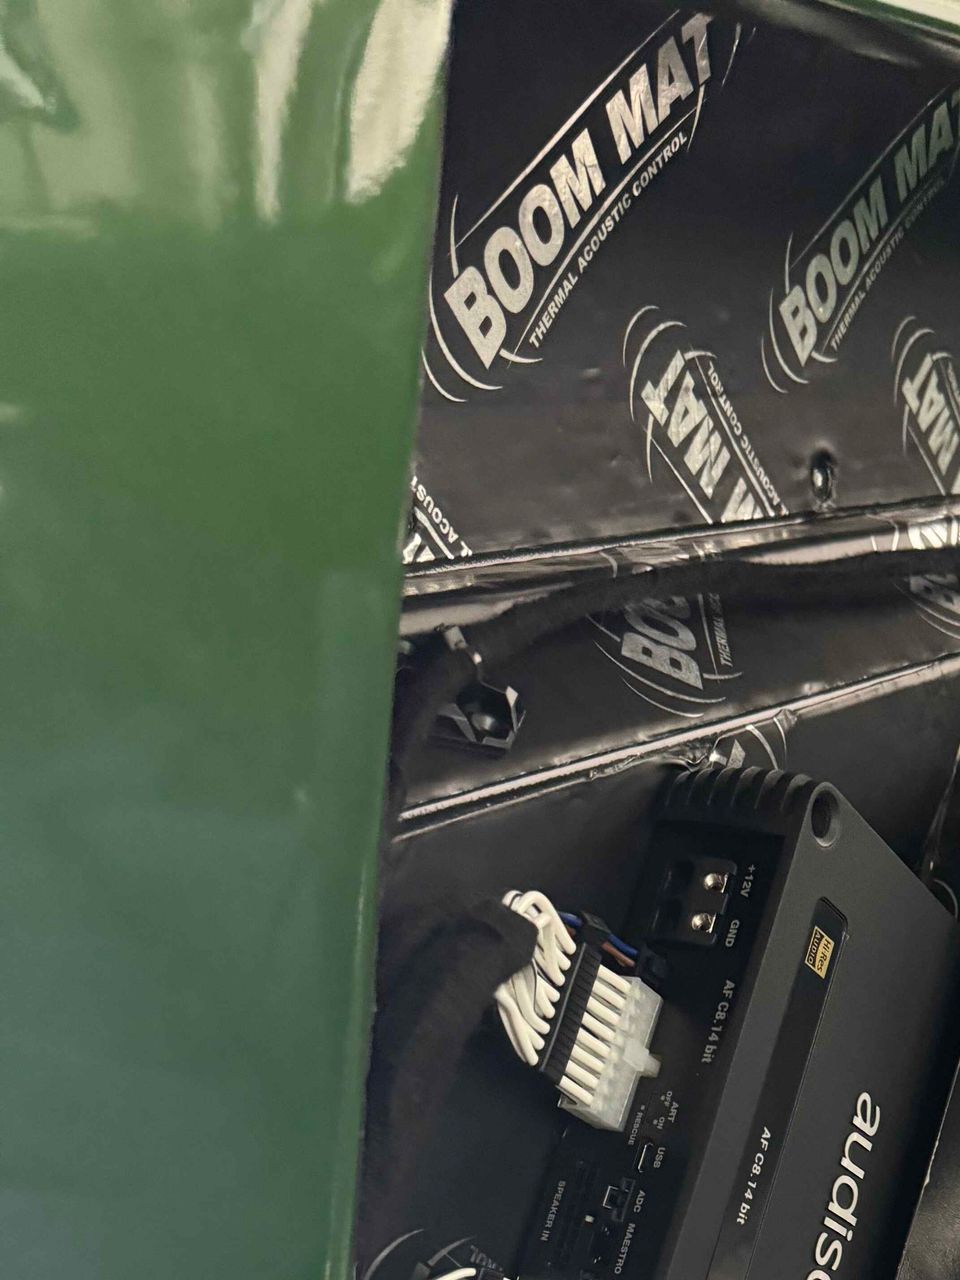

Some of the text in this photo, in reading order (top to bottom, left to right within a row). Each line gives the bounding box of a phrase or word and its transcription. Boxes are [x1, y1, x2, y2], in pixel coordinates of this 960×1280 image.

[443, 12, 714, 370] BOOM MAT
[529, 131, 688, 349] THERMAL ACOUSTIC CONTROL
[779, 175, 888, 367] BOOM
[830, 290, 866, 352] THERMAL
[640, 349, 731, 500] MAT
[707, 360, 743, 436] CONTROL
[741, 435, 781, 506] ACOUSTIC
[740, 863, 756, 899] +12V
[724, 918, 741, 948] GND
[807, 930, 823, 966] AUDIO
[816, 938, 833, 974] Hi-Res
[701, 979, 737, 1064] AF C8.14 bit
[656, 1116, 665, 1130] ON
[664, 1090, 673, 1107] OFF
[667, 1101, 680, 1123] ART
[628, 1112, 643, 1146] RESCUE
[653, 1146, 666, 1168] USB
[736, 1126, 771, 1225] AF C8.14 bit
[540, 1180, 566, 1242] SPEAKER IN
[633, 1189, 646, 1214] ADC
[614, 1222, 636, 1275] MAESTRO
